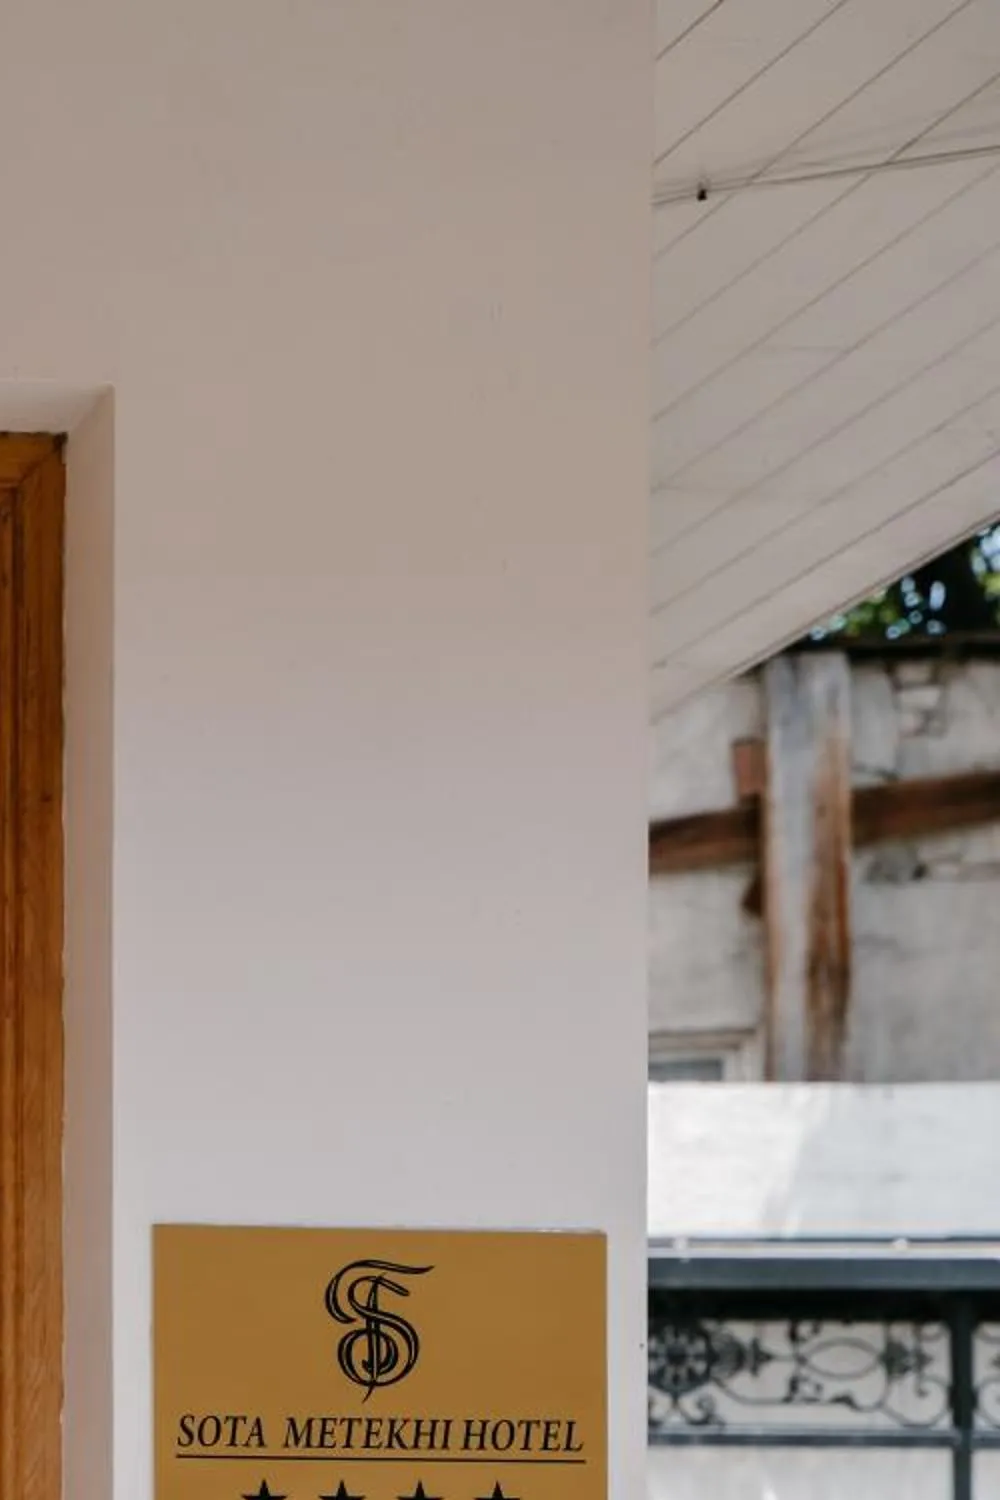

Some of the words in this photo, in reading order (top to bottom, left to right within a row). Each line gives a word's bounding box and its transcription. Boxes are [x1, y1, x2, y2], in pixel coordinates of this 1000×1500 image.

[177, 1415, 267, 1448] SOTA
[283, 1417, 453, 1450] METEKHI
[461, 1419, 583, 1452] HOTEL
